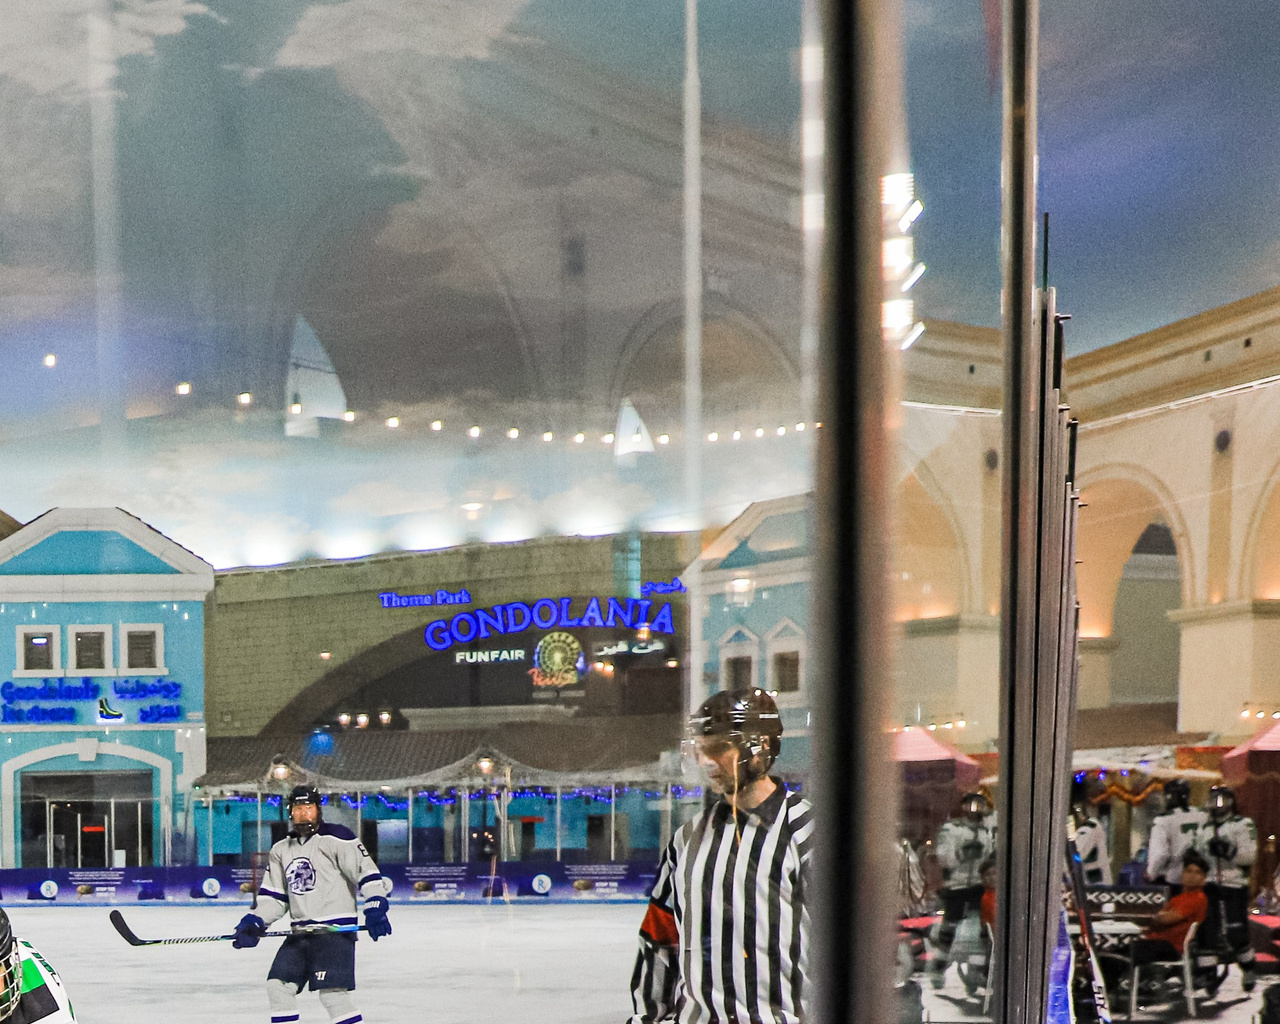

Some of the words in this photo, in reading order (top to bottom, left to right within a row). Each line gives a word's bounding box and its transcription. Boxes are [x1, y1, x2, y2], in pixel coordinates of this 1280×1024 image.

[378, 591, 434, 609] Theme
[435, 588, 472, 606] Park
[424, 597, 675, 651] GONDOLANIA
[455, 649, 526, 664] FUNFAIR
